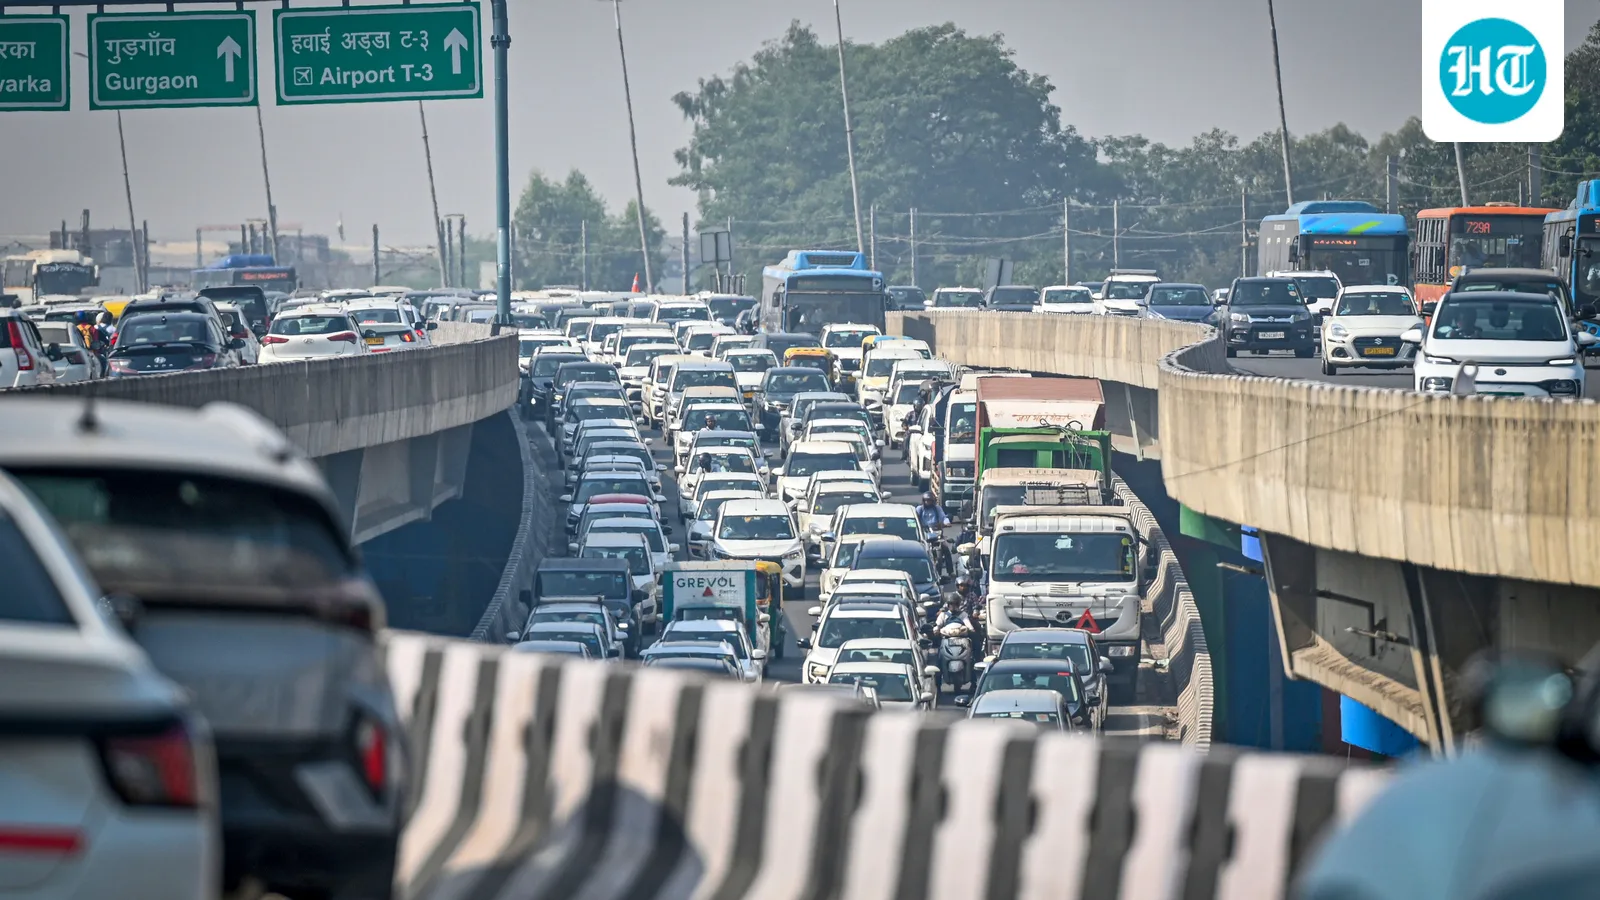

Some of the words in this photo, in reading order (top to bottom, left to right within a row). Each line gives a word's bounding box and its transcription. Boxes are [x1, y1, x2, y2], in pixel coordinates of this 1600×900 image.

[104, 31, 176, 64] गुड़गाँव
[290, 26, 331, 54] हवाई
[341, 31, 390, 56] अड्डा
[400, 30, 429, 51] ट-३
[105, 73, 198, 94] Gurgaon
[320, 66, 395, 88] Airport
[401, 63, 434, 81] T-3
[1466, 221, 1492, 234] 729A
[676, 577, 736, 588] GREVOL
